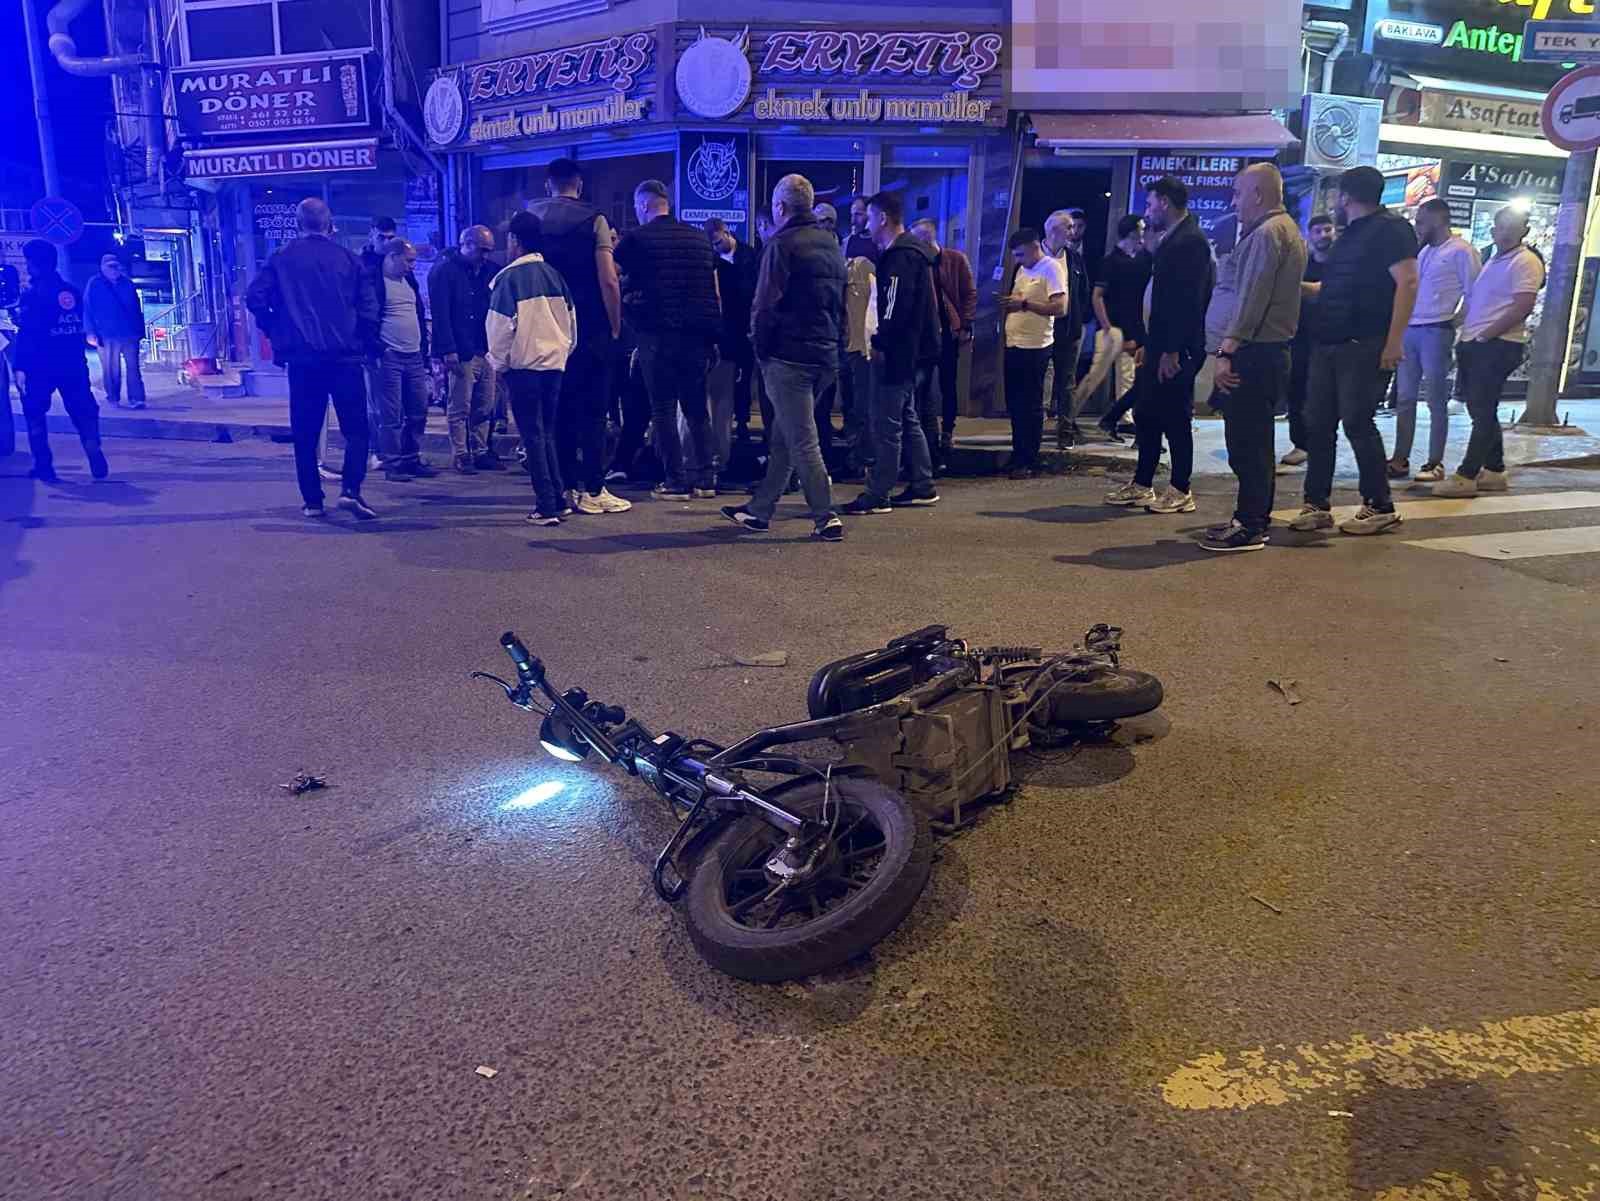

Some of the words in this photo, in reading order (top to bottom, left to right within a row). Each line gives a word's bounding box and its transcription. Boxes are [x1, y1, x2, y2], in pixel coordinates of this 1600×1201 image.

[1387, 23, 1437, 40] BAKLAVA
[1542, 36, 1576, 48] TEK
[180, 65, 331, 93] MURATLI
[199, 91, 317, 114] DÖNER
[753, 88, 829, 121] ekmek
[831, 88, 881, 121] unlu
[884, 90, 991, 121] mamüller
[469, 111, 522, 142] ekmek
[522, 104, 558, 135] unlu
[559, 90, 646, 129] mamüller
[190, 153, 284, 176] MURATLI
[291, 147, 371, 170] DÖNER
[1141, 156, 1239, 171] EMEKLİLERE
[1460, 164, 1557, 189] A'Saftat
